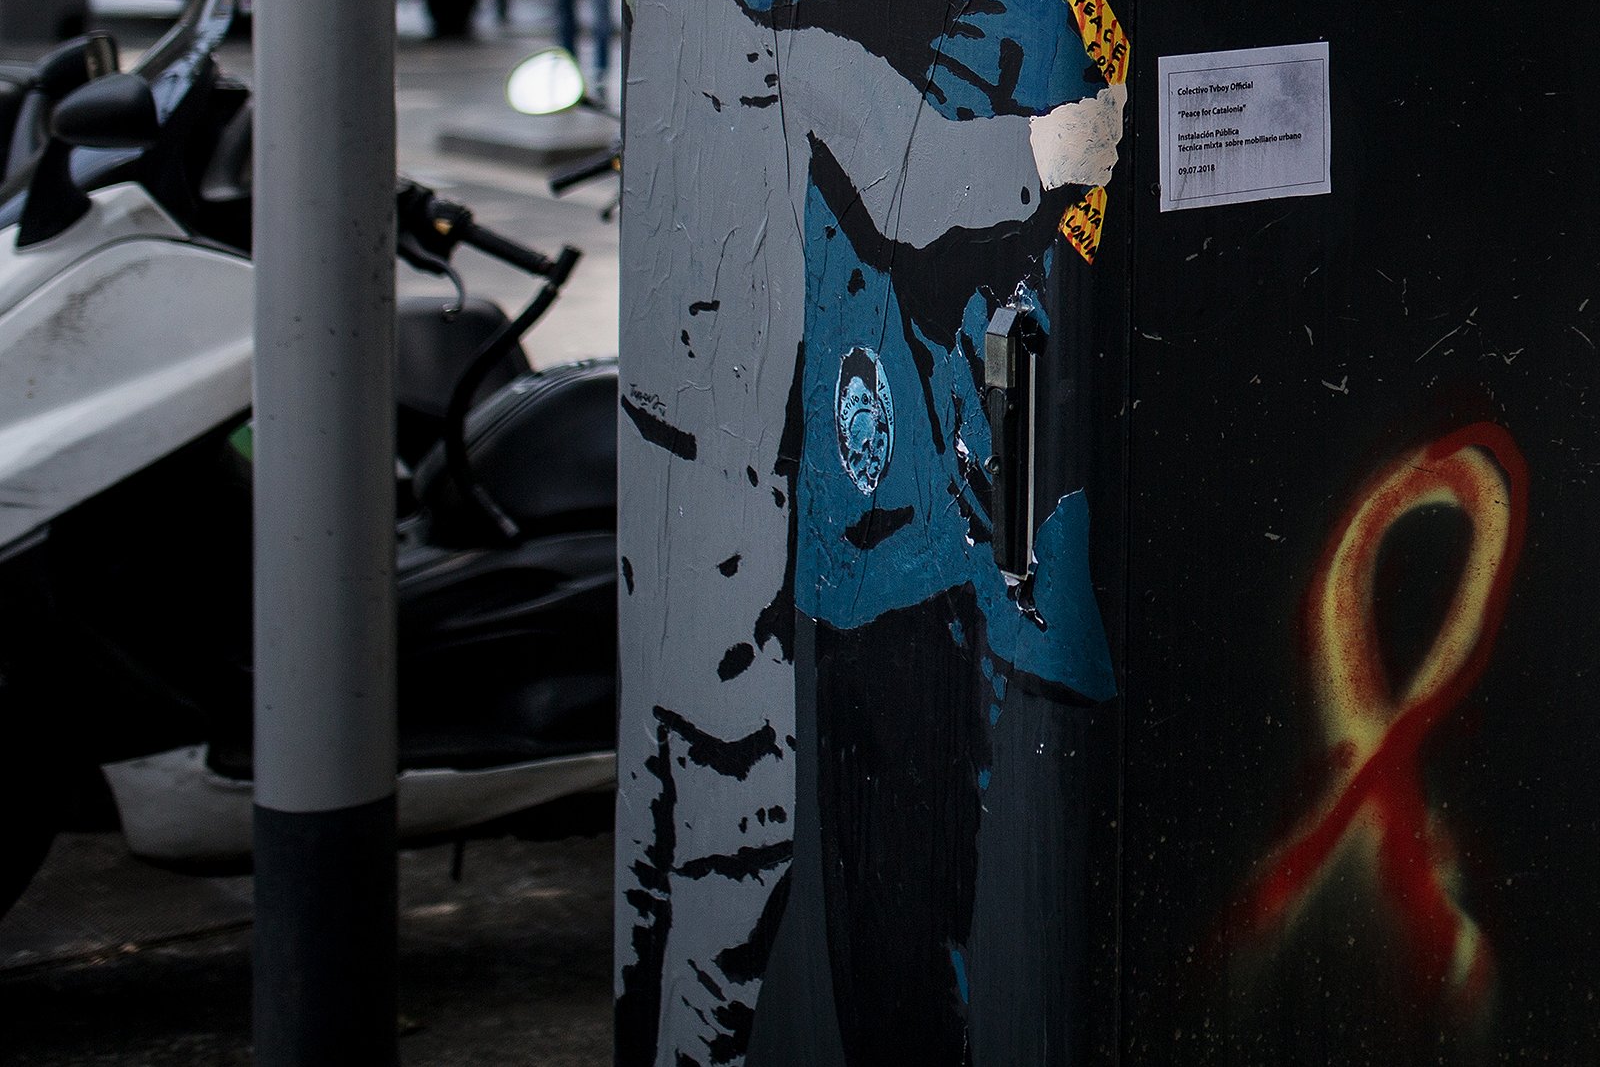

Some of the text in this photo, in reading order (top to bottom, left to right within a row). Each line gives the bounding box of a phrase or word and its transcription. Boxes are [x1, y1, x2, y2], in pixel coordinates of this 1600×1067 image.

[1087, 41, 1116, 79] FOR
[1177, 81, 1254, 96] Colectivo Tvboy Official
[1201, 108, 1211, 116] for
[1178, 128, 1239, 141] Instalación Pública
[1178, 132, 1302, 152] Técnica mixta sobre mobiliario urbano
[1178, 164, 1215, 175] 09.07.2018
